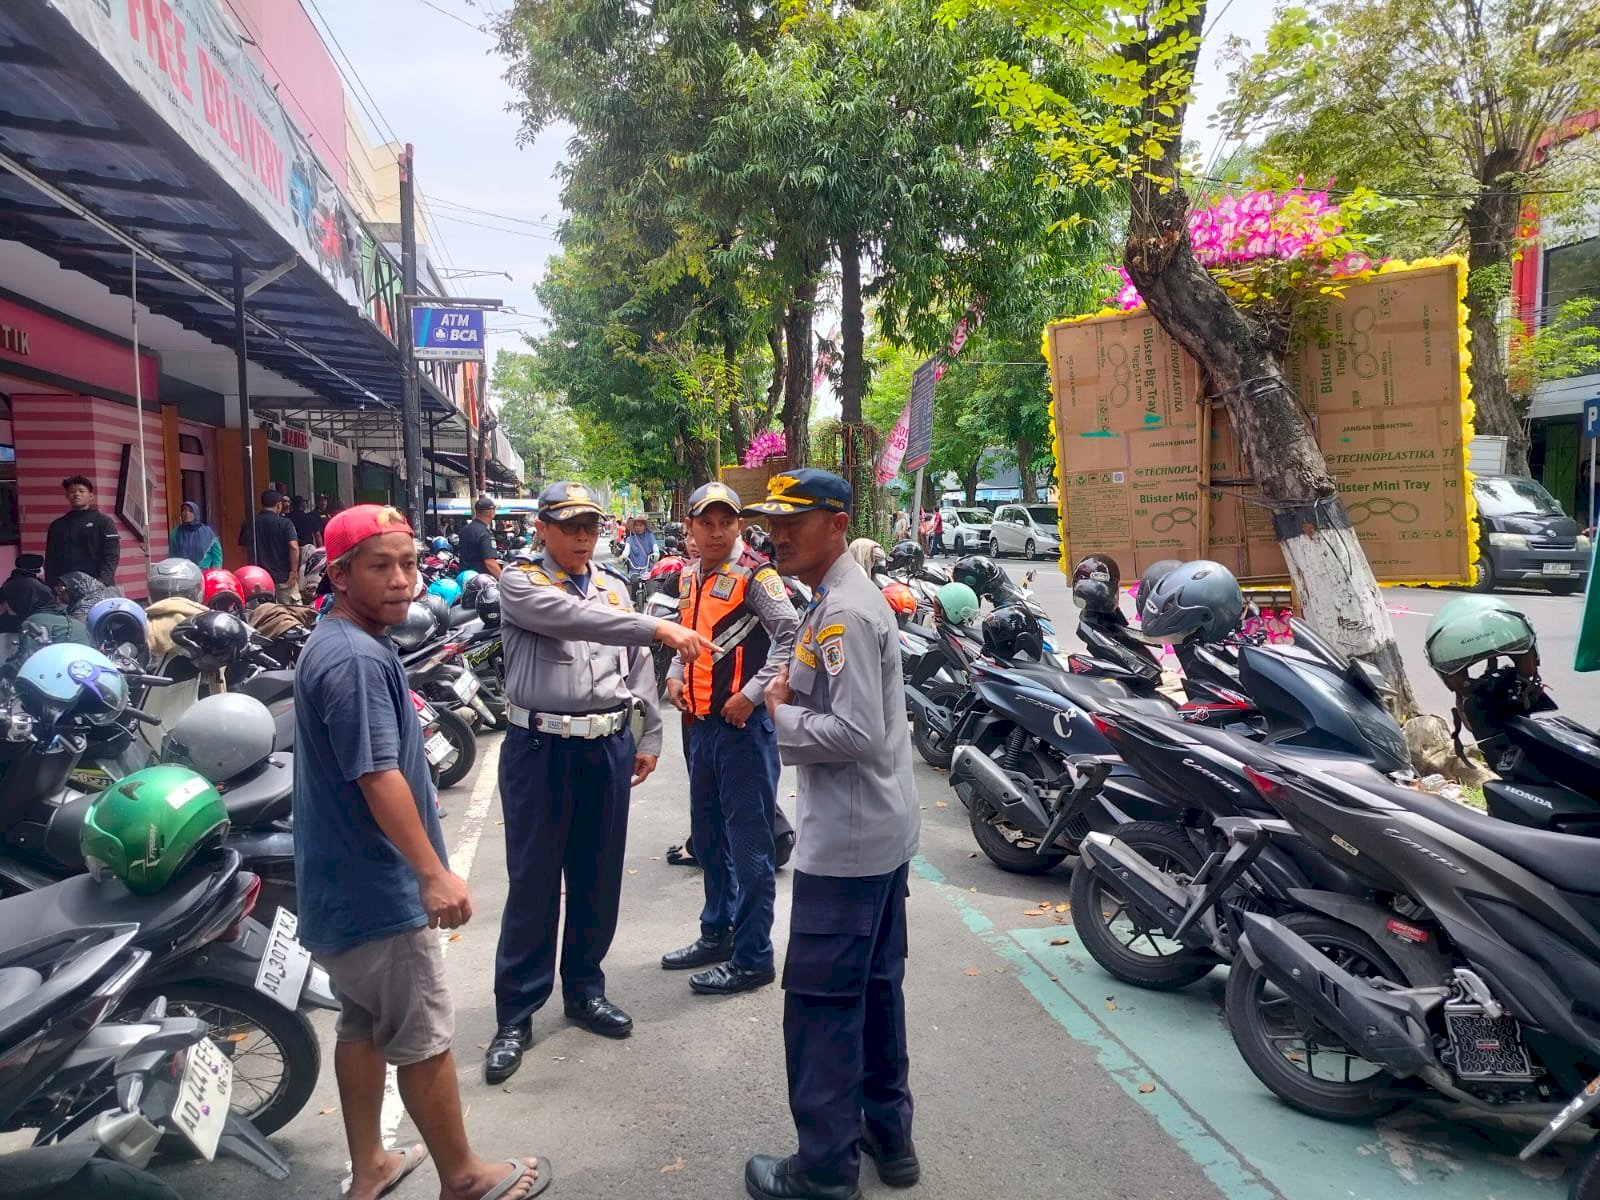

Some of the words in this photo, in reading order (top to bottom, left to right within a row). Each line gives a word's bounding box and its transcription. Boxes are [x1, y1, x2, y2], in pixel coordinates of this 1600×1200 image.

[197, 44, 286, 208] DELIVERY
[440, 313, 470, 327] ATM
[1335, 312, 1343, 331] mm
[2, 324, 31, 356] TIK
[449, 328, 478, 342] BCA
[1143, 328, 1154, 366] Blister
[1132, 344, 1141, 372] Tinggi
[1335, 347, 1347, 376] Tinggi
[1144, 368, 1156, 388] Big
[1169, 337, 1183, 413] CHNOPLASTIKA
[1319, 353, 1333, 394] Blister
[1135, 385, 1143, 402] mm
[1146, 389, 1158, 414] Tray
[1341, 424, 1371, 433] JANGAN
[1373, 421, 1413, 431] DIBANTING
[1588, 406, 1598, 431] P
[1336, 449, 1435, 464] TECHNOPLASTIKA
[1139, 493, 1172, 504] Blister
[1175, 490, 1198, 502] Mini
[1336, 481, 1369, 494] lister
[1373, 480, 1400, 491] Mini
[1403, 479, 1430, 492] Tray
[1503, 785, 1554, 809] HONDA
[268, 930, 290, 970] 3077
[262, 972, 280, 995] AD
[188, 1060, 211, 1103] 4441
[180, 1101, 201, 1134] AD
